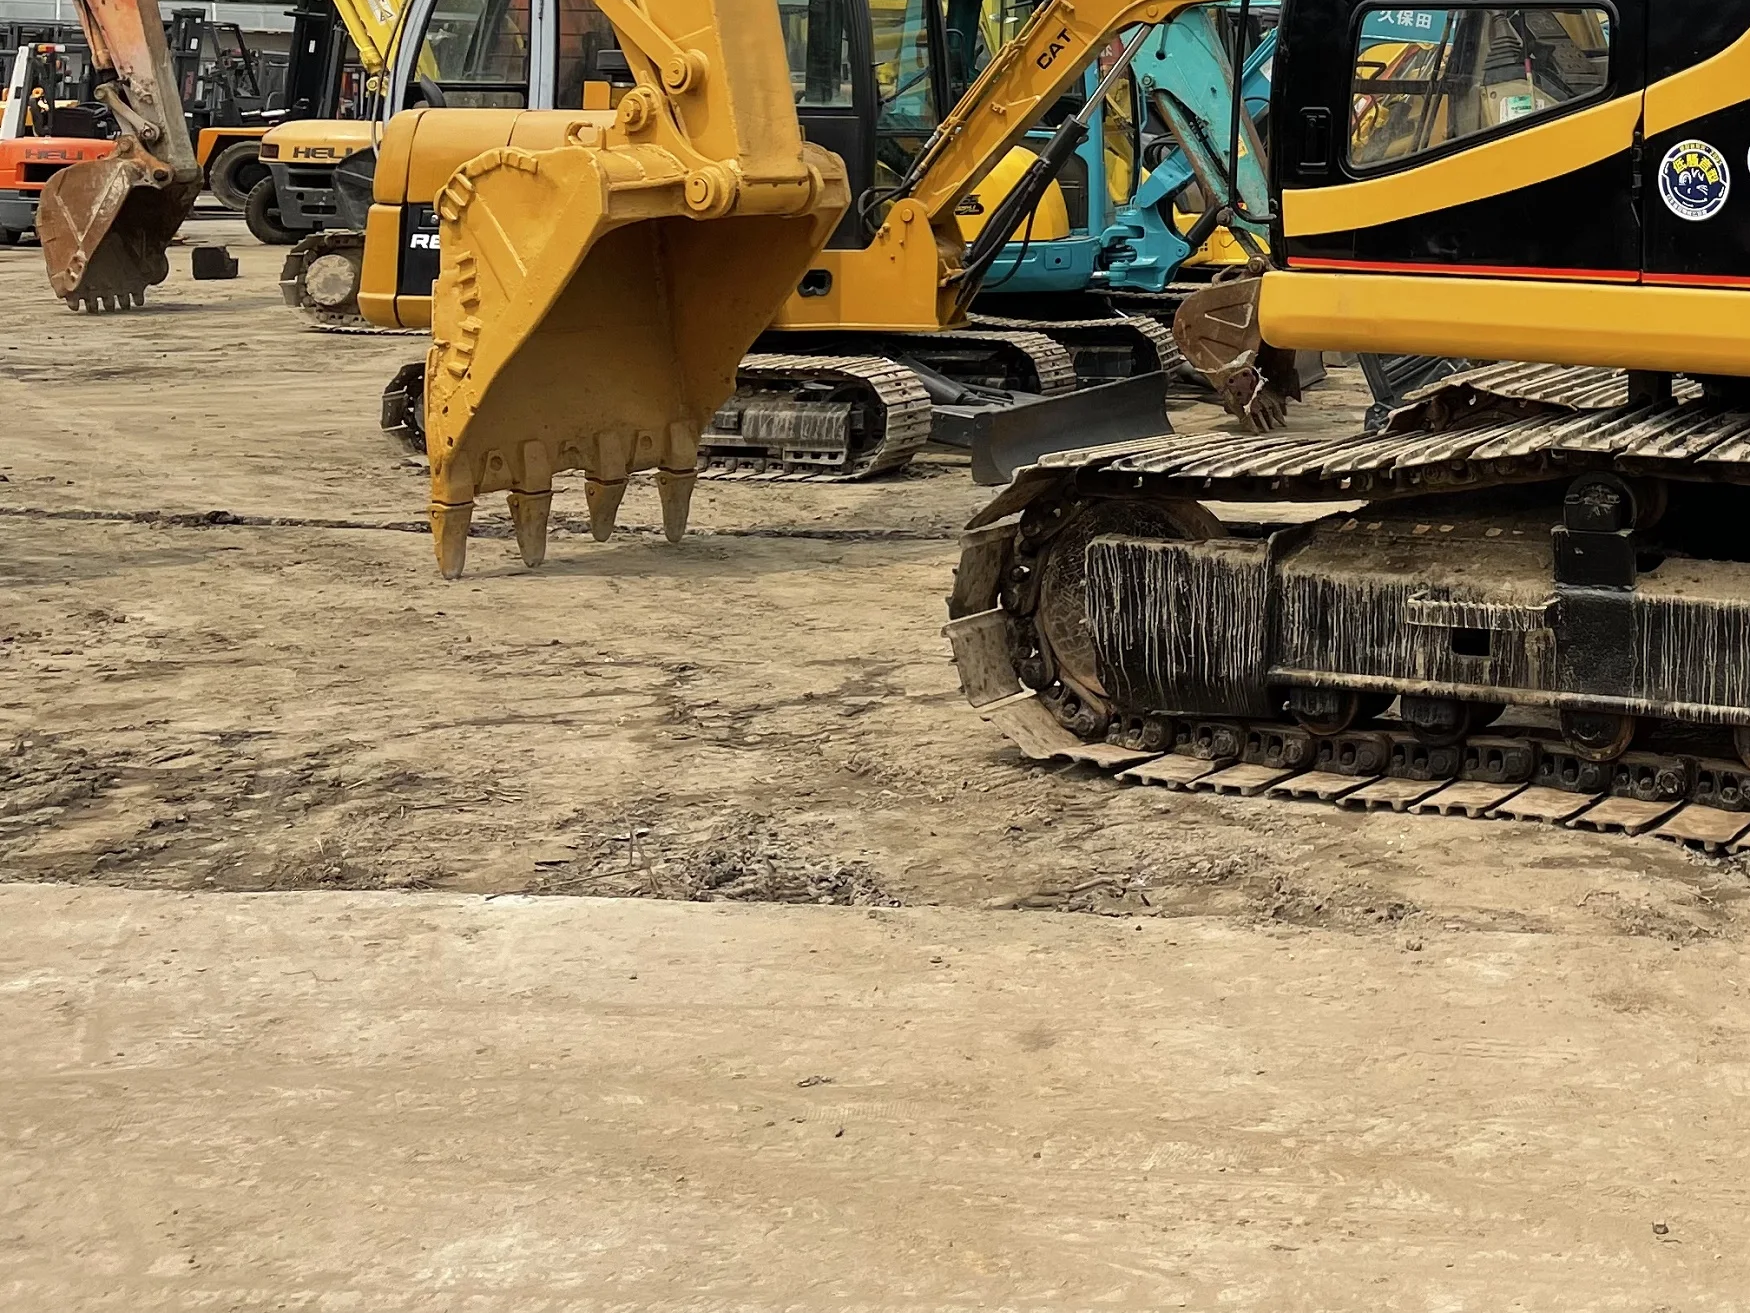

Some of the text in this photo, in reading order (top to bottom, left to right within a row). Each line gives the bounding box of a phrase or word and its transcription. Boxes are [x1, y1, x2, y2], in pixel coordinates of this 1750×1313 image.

[1377, 10, 1432, 29] 久保田
[1036, 28, 1071, 70] CAT
[410, 233, 440, 250] RE
